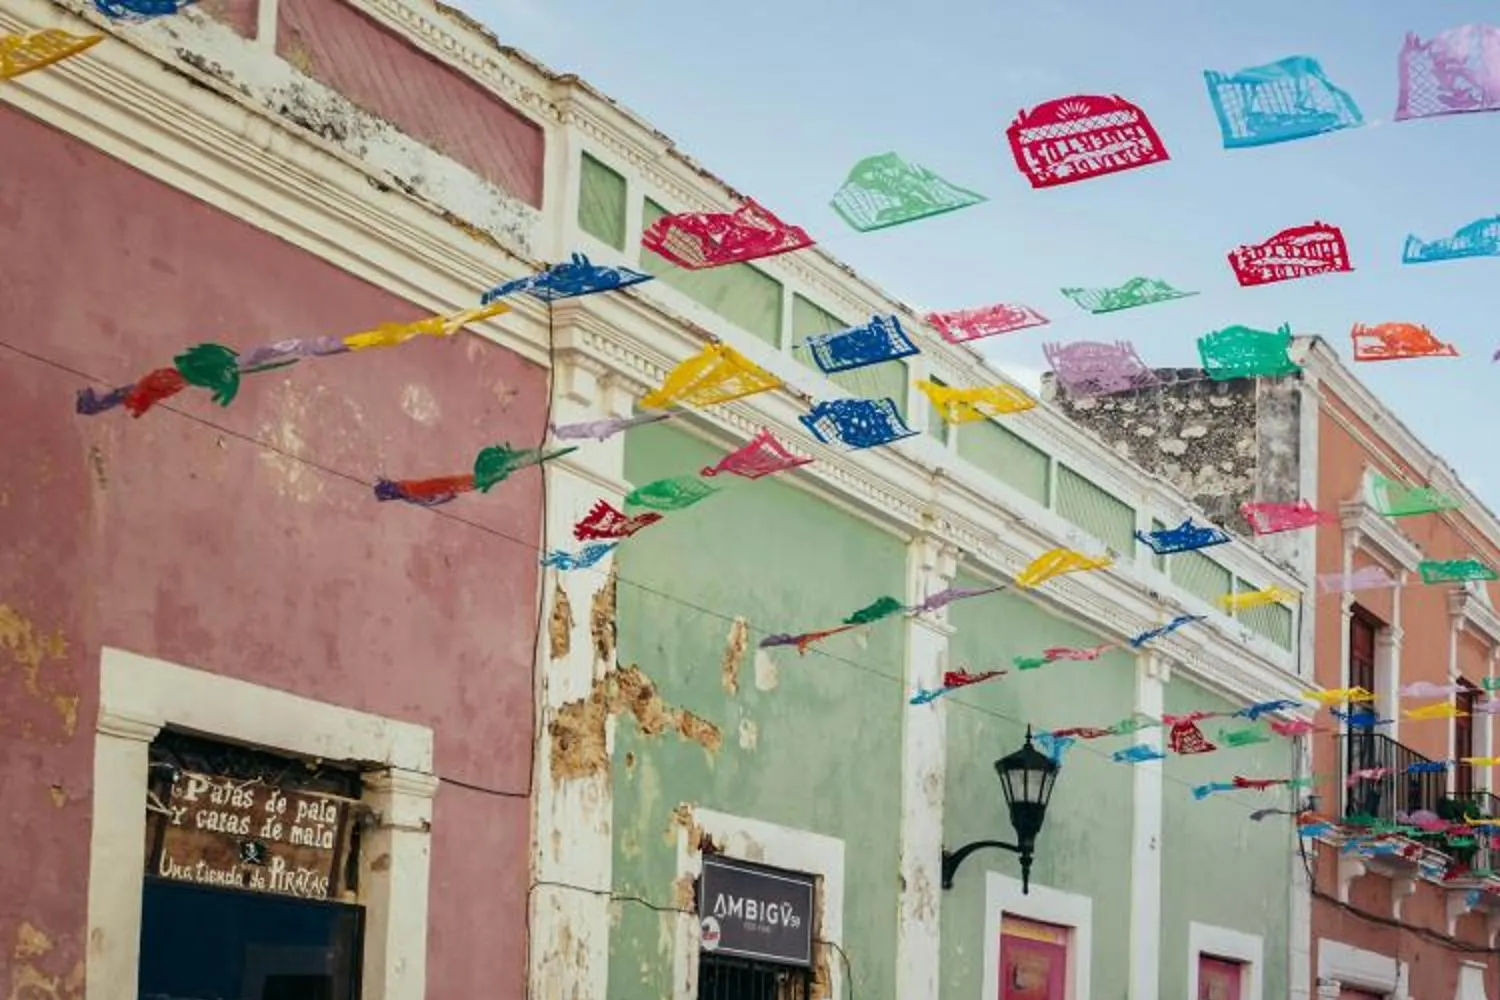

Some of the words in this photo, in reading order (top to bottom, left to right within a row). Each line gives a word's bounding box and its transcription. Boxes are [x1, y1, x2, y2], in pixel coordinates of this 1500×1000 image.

[183, 776, 254, 808] Patas
[265, 789, 287, 814] de
[295, 798, 337, 823] palo
[195, 810, 251, 835] caras
[260, 815, 283, 840] de
[290, 824, 333, 849] malo
